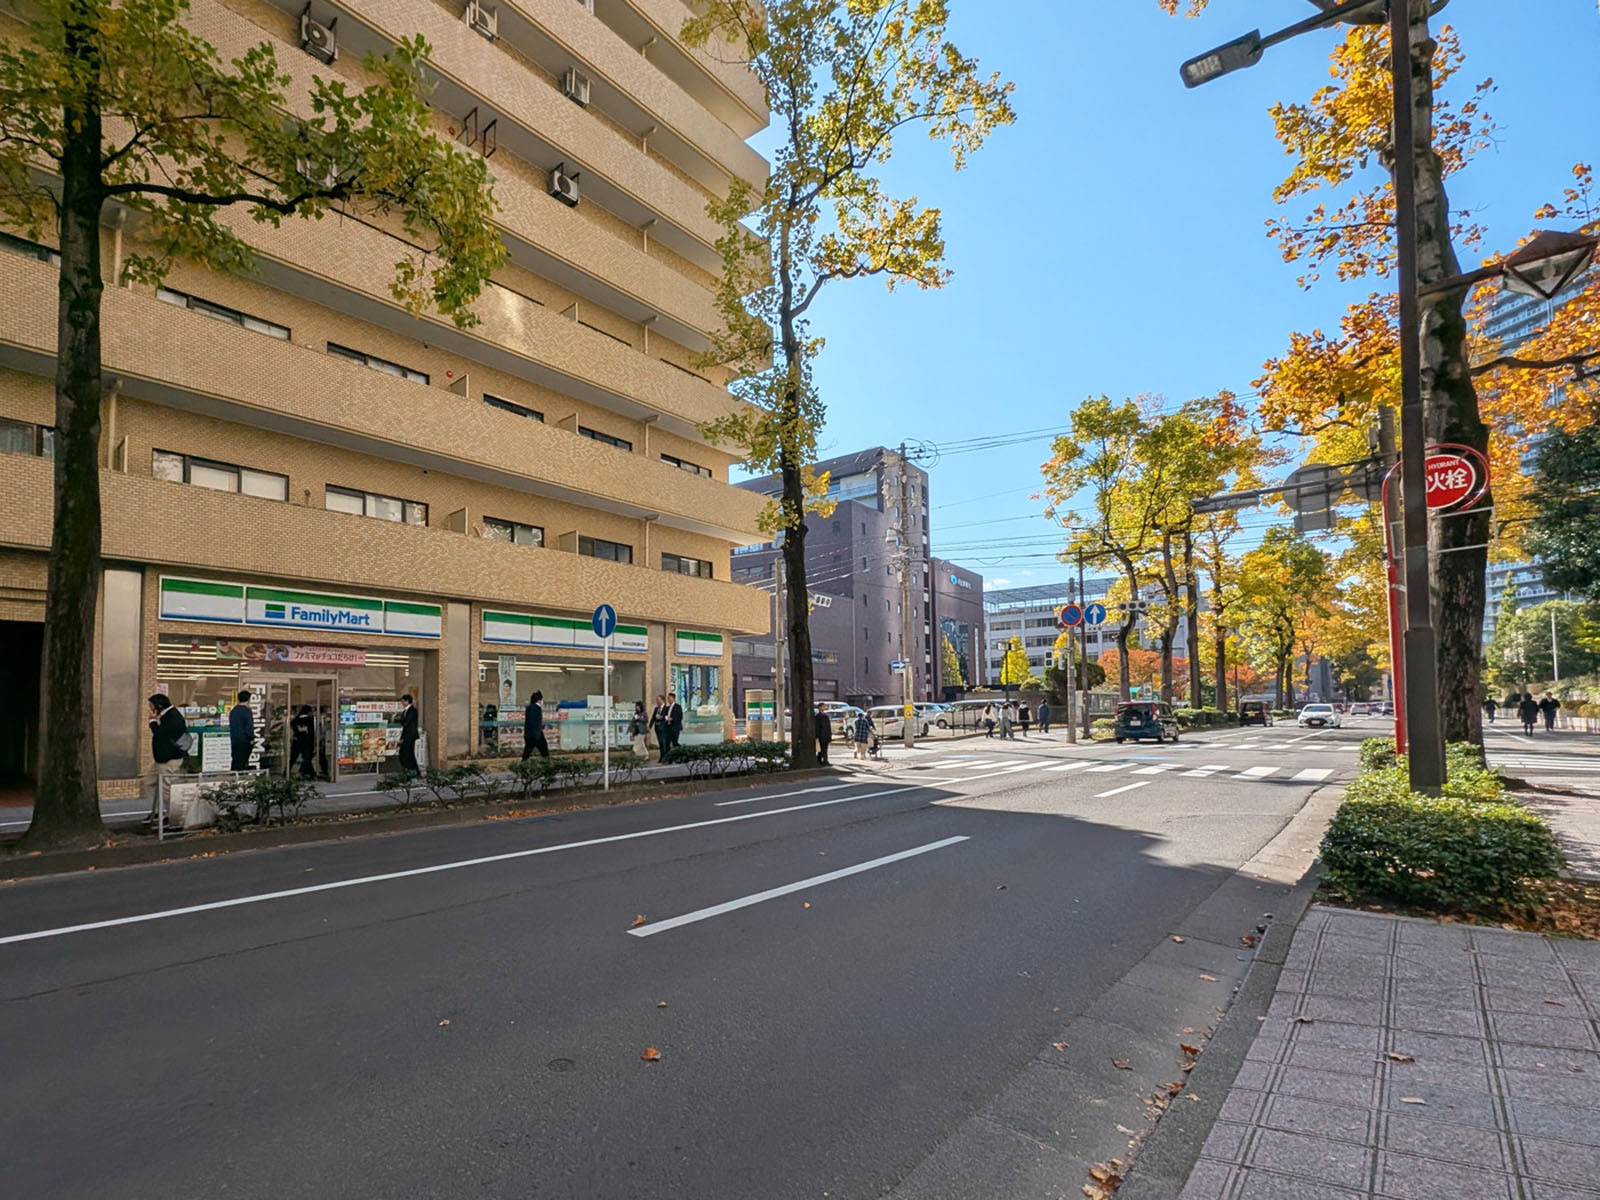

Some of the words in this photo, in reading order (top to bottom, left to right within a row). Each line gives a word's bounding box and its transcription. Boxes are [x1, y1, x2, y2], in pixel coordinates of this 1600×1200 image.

[1428, 459, 1460, 470] HYDRANT
[1425, 468, 1468, 493] 火栓
[291, 606, 370, 626] FamilyMart
[248, 684, 266, 776] FamilyMar
